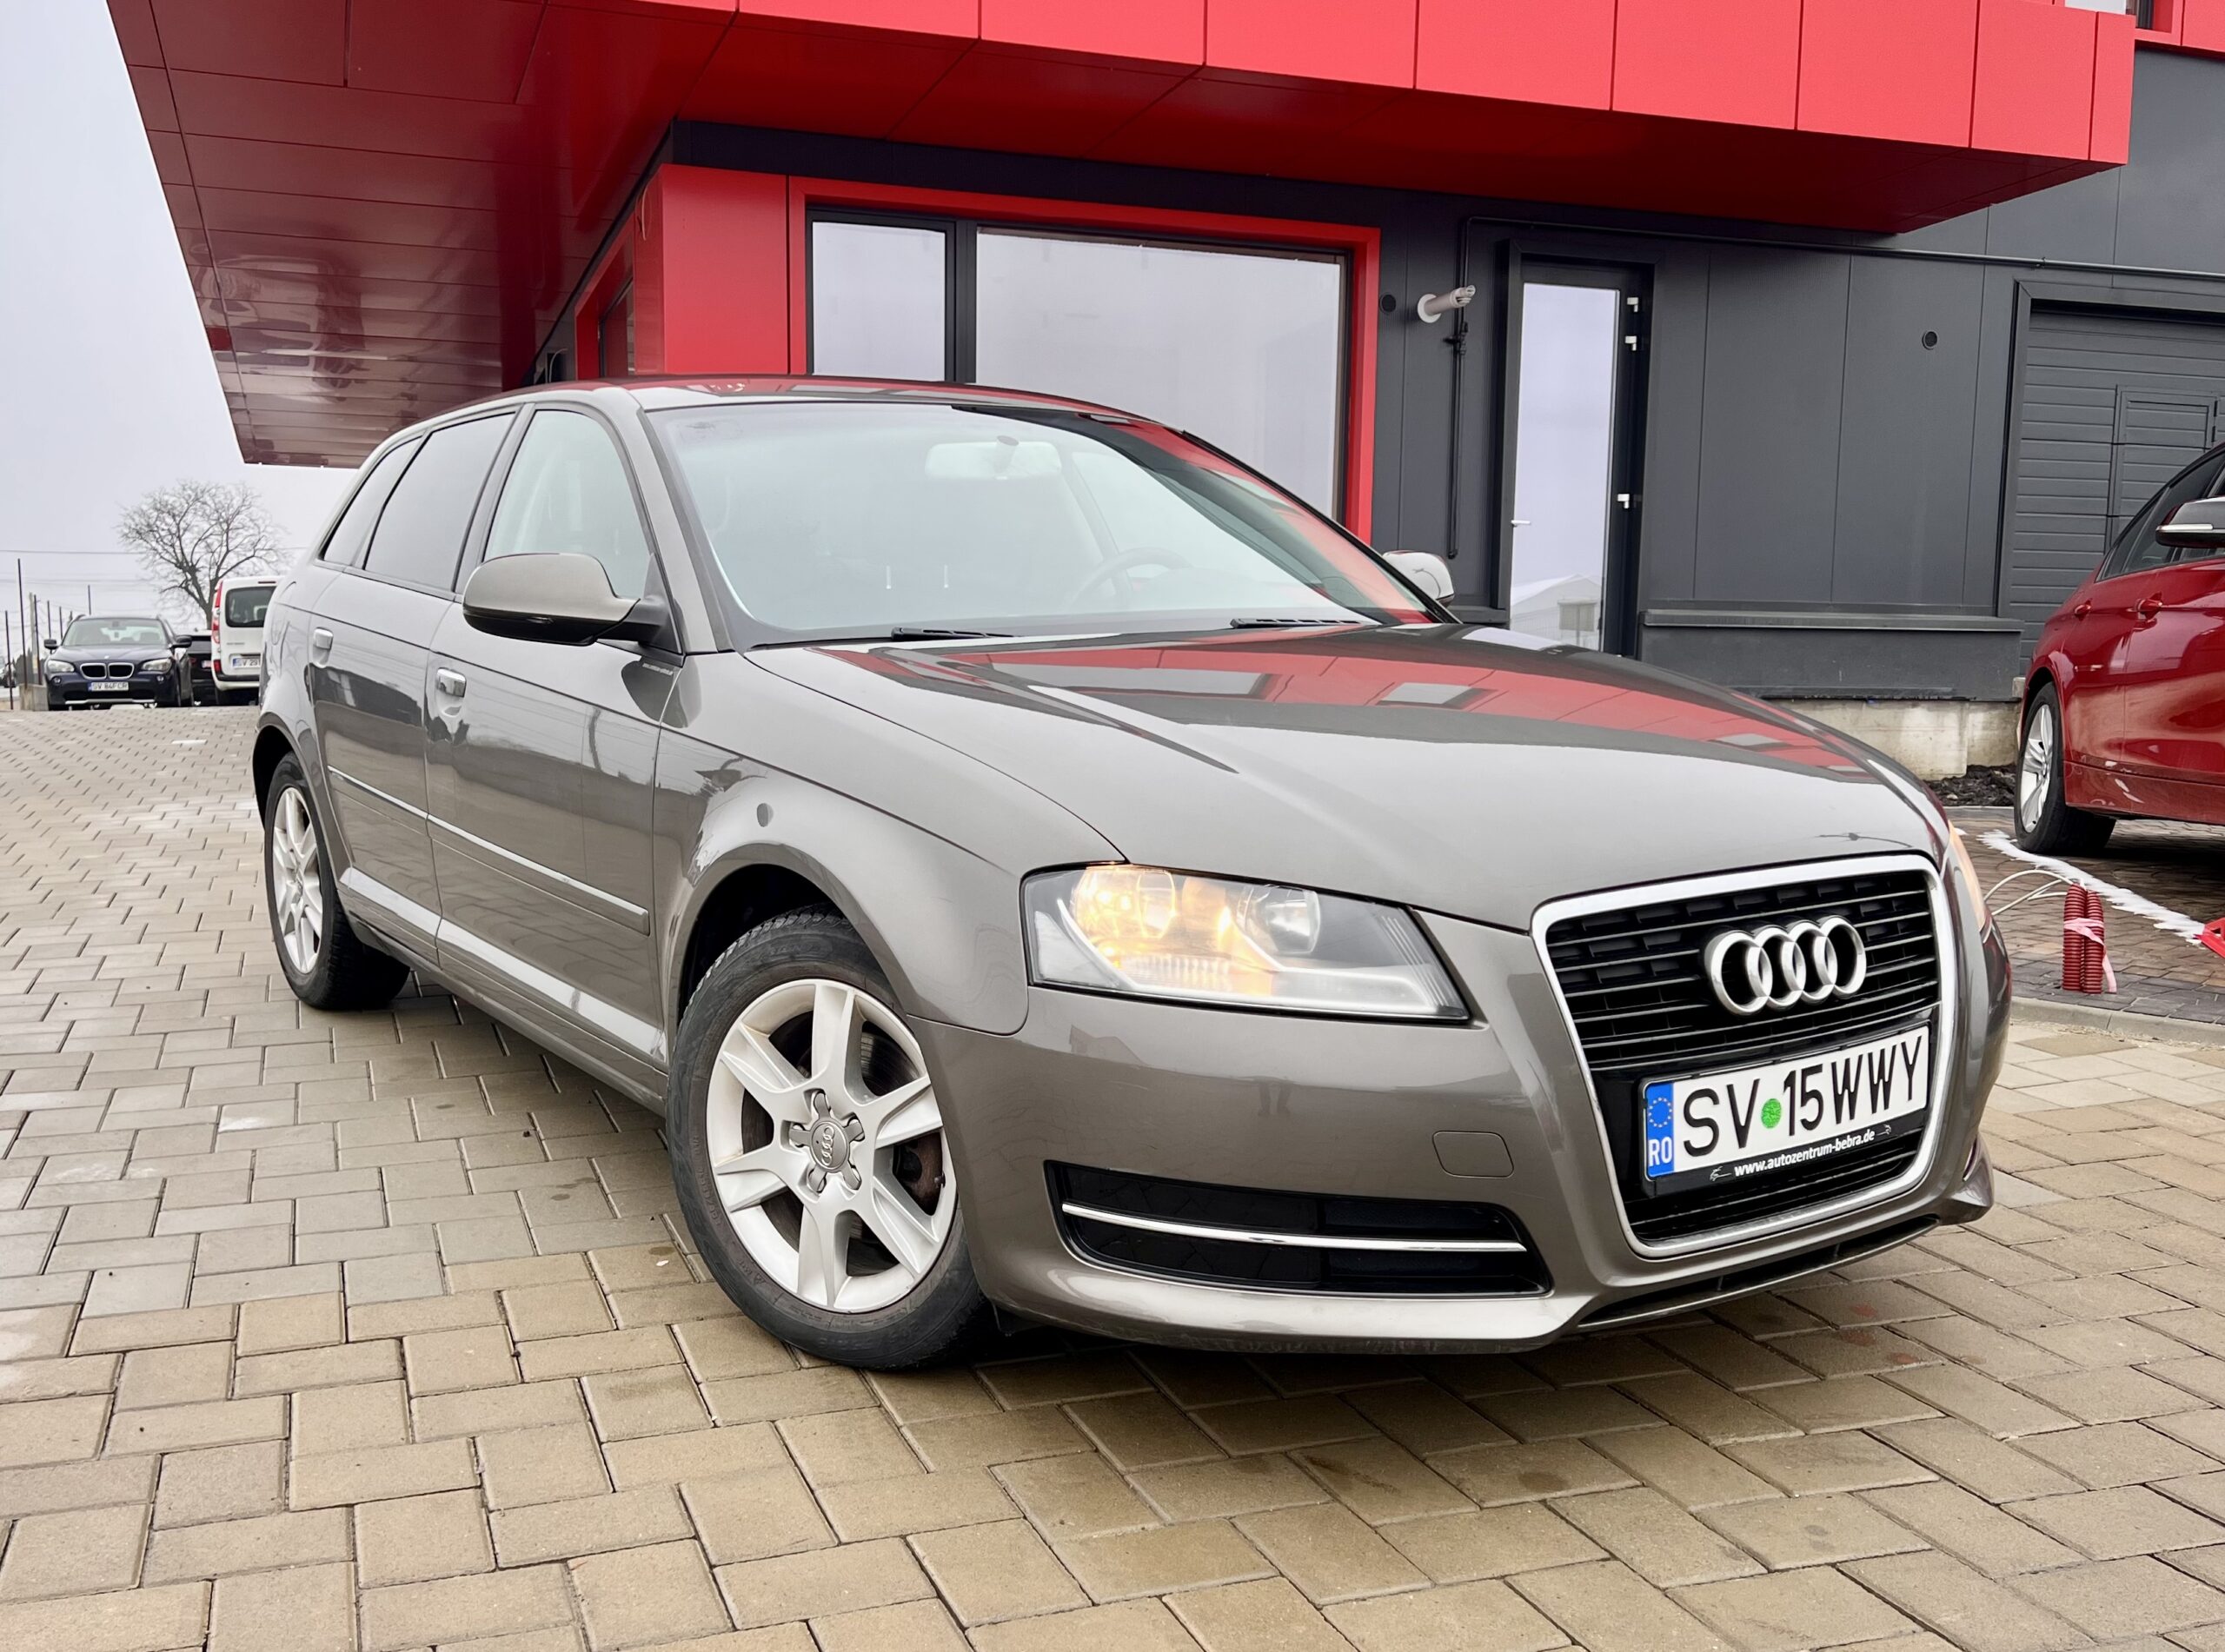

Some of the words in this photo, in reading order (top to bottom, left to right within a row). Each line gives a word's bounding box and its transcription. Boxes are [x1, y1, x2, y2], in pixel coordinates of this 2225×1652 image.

[1683, 1078, 1761, 1158] SV
[1783, 1035, 1923, 1137] 15WWY
[1648, 1136, 1673, 1168] RO
[1733, 1129, 1876, 1178] www.autozentrum-bebra.de
